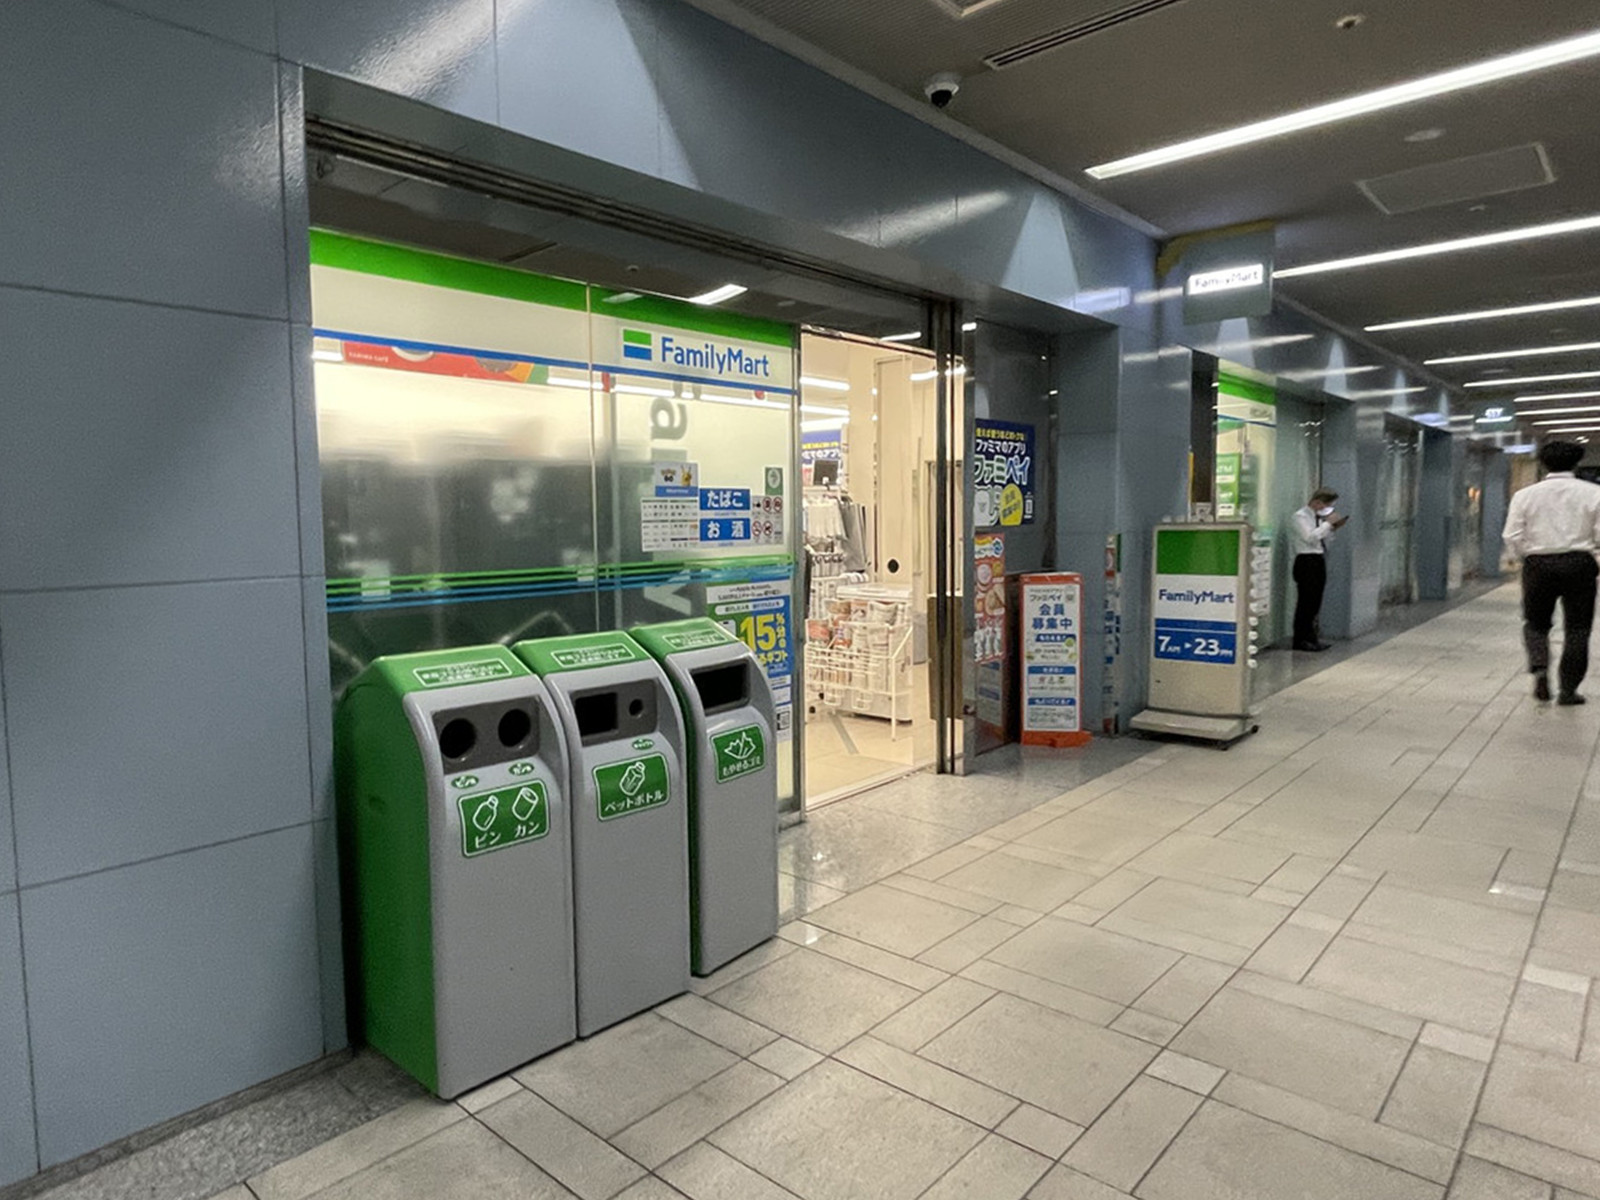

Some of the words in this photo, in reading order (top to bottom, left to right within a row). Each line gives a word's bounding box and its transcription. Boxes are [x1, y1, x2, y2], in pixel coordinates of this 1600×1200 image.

[661, 336, 769, 377] FamilyMart
[976, 439, 1026, 455] ファミマのアプリ
[974, 454, 1031, 486] ファミペイ
[707, 490, 743, 508] たばこ
[1158, 588, 1234, 605] FamilyMart
[1039, 603, 1065, 616] 会員
[740, 613, 776, 652] 15
[1032, 617, 1072, 630] 募集中
[604, 790, 664, 811] ペットボトル
[475, 831, 501, 849] ビン
[514, 821, 540, 838] カン
